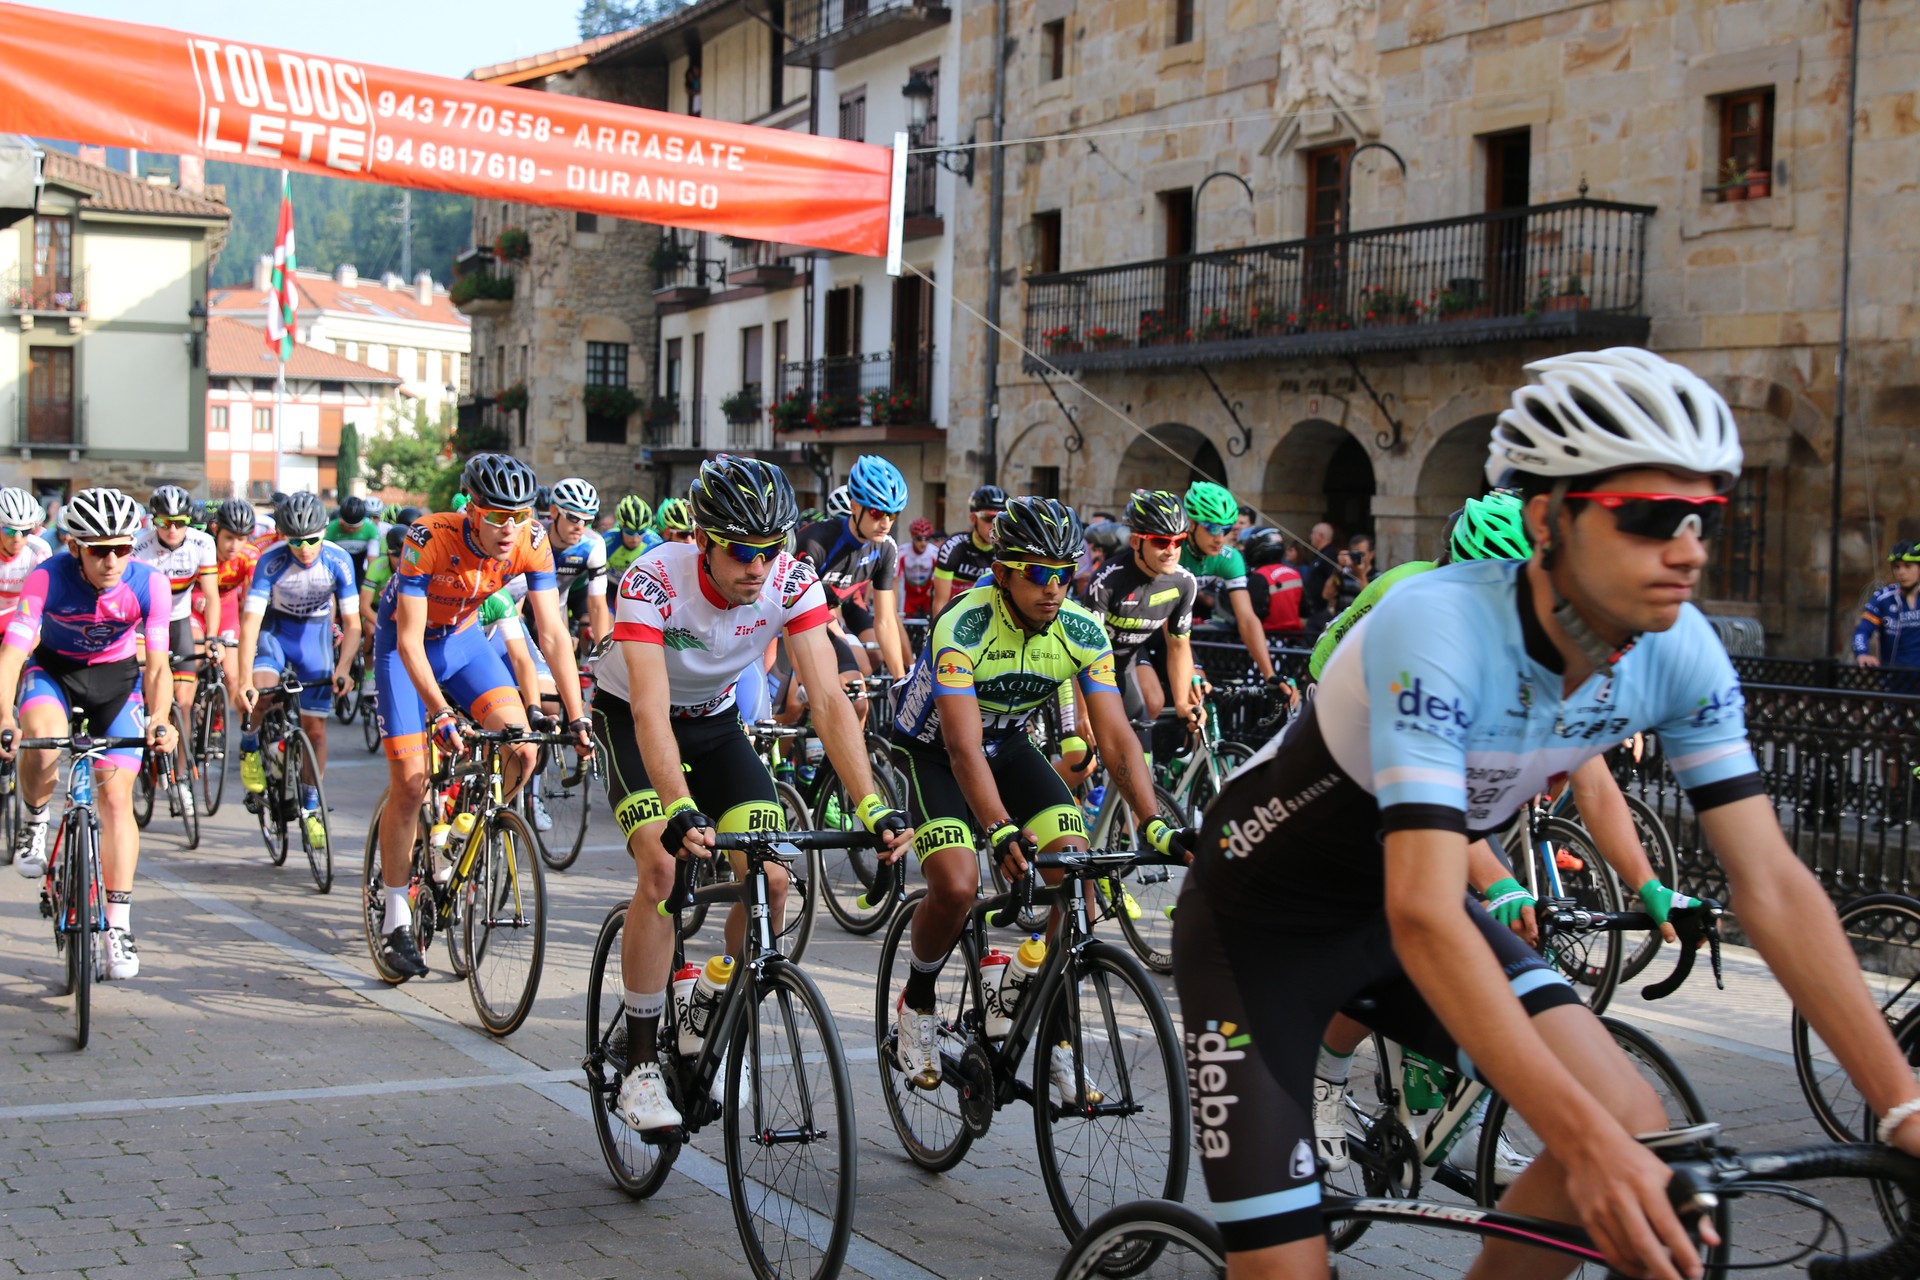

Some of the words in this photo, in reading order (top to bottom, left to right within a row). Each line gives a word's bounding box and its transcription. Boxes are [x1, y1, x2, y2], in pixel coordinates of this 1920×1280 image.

[194, 39, 367, 126] TOLDOS
[204, 107, 366, 172] LETE
[377, 90, 435, 123] 943
[573, 123, 746, 171] ARRASATE
[566, 165, 719, 210] DURANGO
[914, 825, 966, 860] RACER
[1228, 796, 1291, 858] deba
[1196, 1032, 1247, 1159] deba
[1353, 1198, 1489, 1225] SCULTURA
